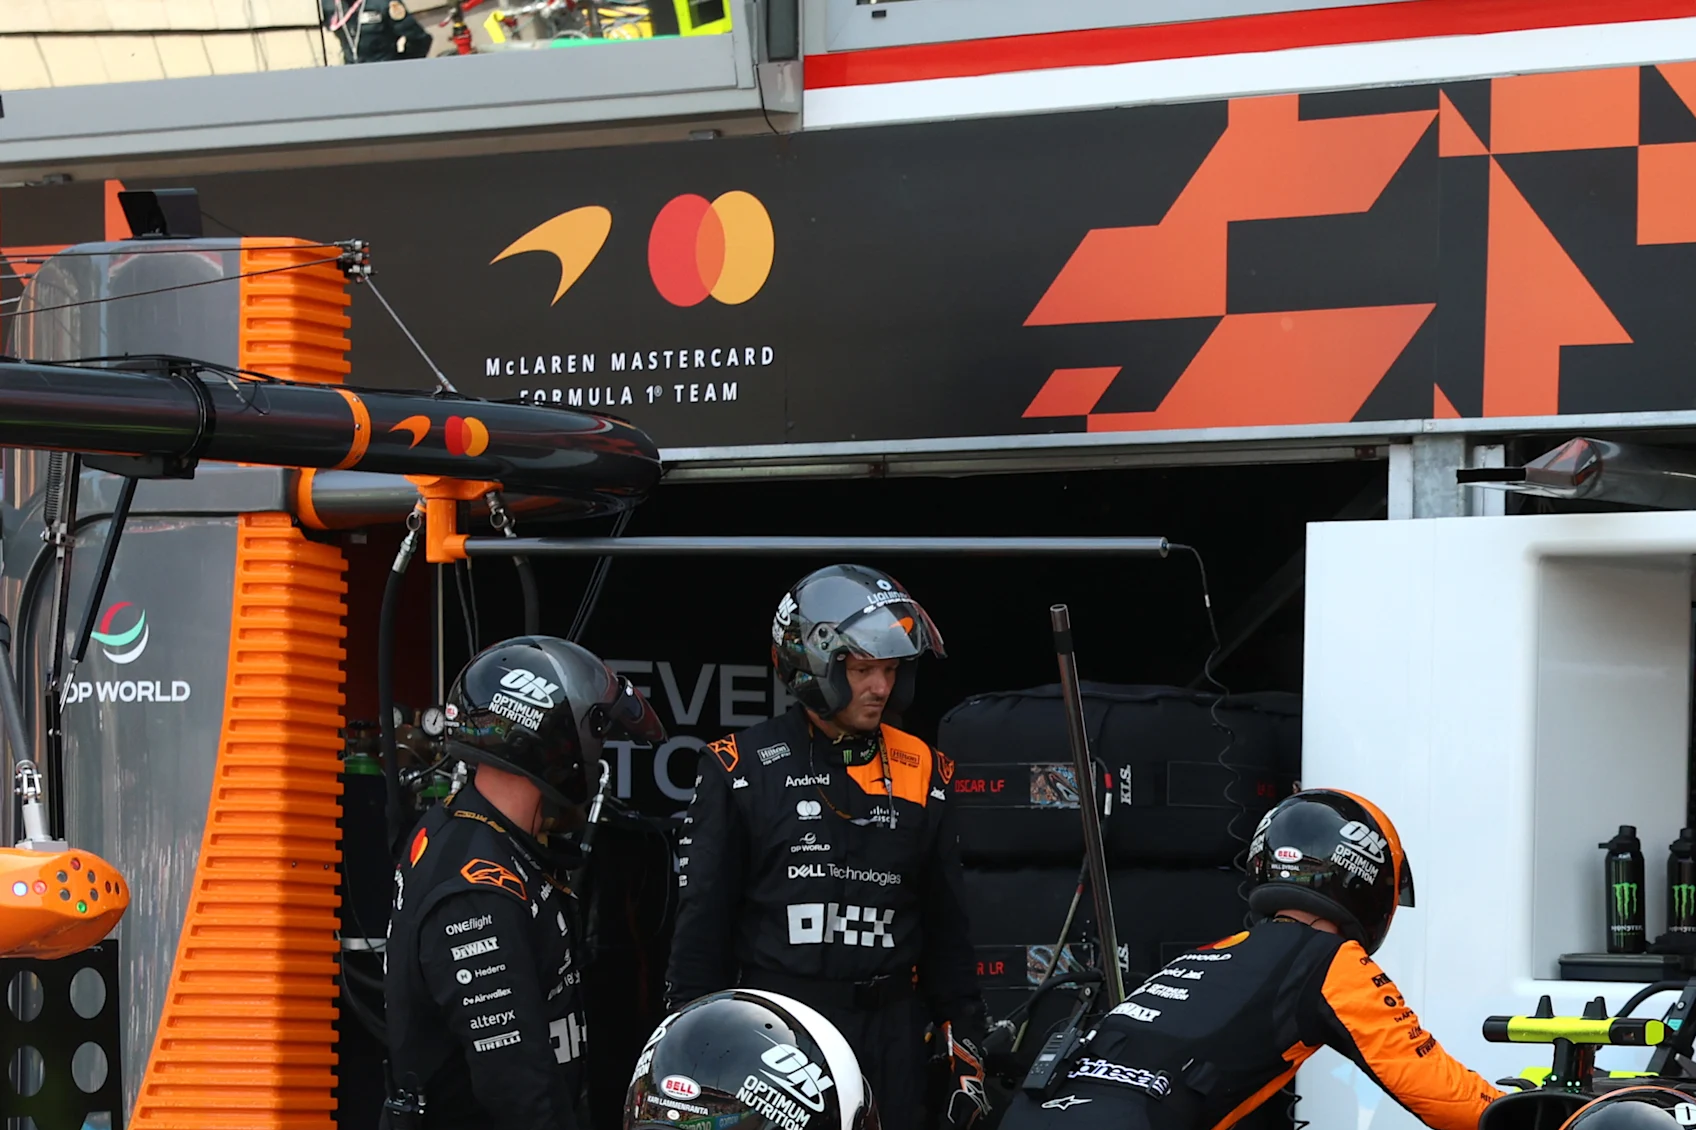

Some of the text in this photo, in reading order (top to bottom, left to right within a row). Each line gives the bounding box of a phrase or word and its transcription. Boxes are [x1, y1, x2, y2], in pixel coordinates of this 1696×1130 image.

[486, 346, 774, 376] McLAREN MASTERCARD
[674, 382, 738, 403] TEAM
[63, 681, 191, 704] DP WORLD
[489, 702, 539, 731] NUTRITION
[493, 693, 544, 722] OPTIMUM
[785, 774, 830, 788] Android
[802, 843, 830, 851] WORLD
[1277, 850, 1298, 859] BELL
[1331, 853, 1375, 886] NUTRITION
[1335, 844, 1379, 878] OPTIMUM
[788, 863, 901, 886] DELL Technologies
[787, 902, 895, 948] OKX
[474, 963, 506, 979] Hedera
[474, 987, 512, 1005] Airwallex
[470, 1009, 516, 1030] alteryx
[474, 1031, 521, 1052] PIRELLI
[665, 1079, 695, 1095] BELL
[742, 1075, 811, 1127] OPTIMUM
